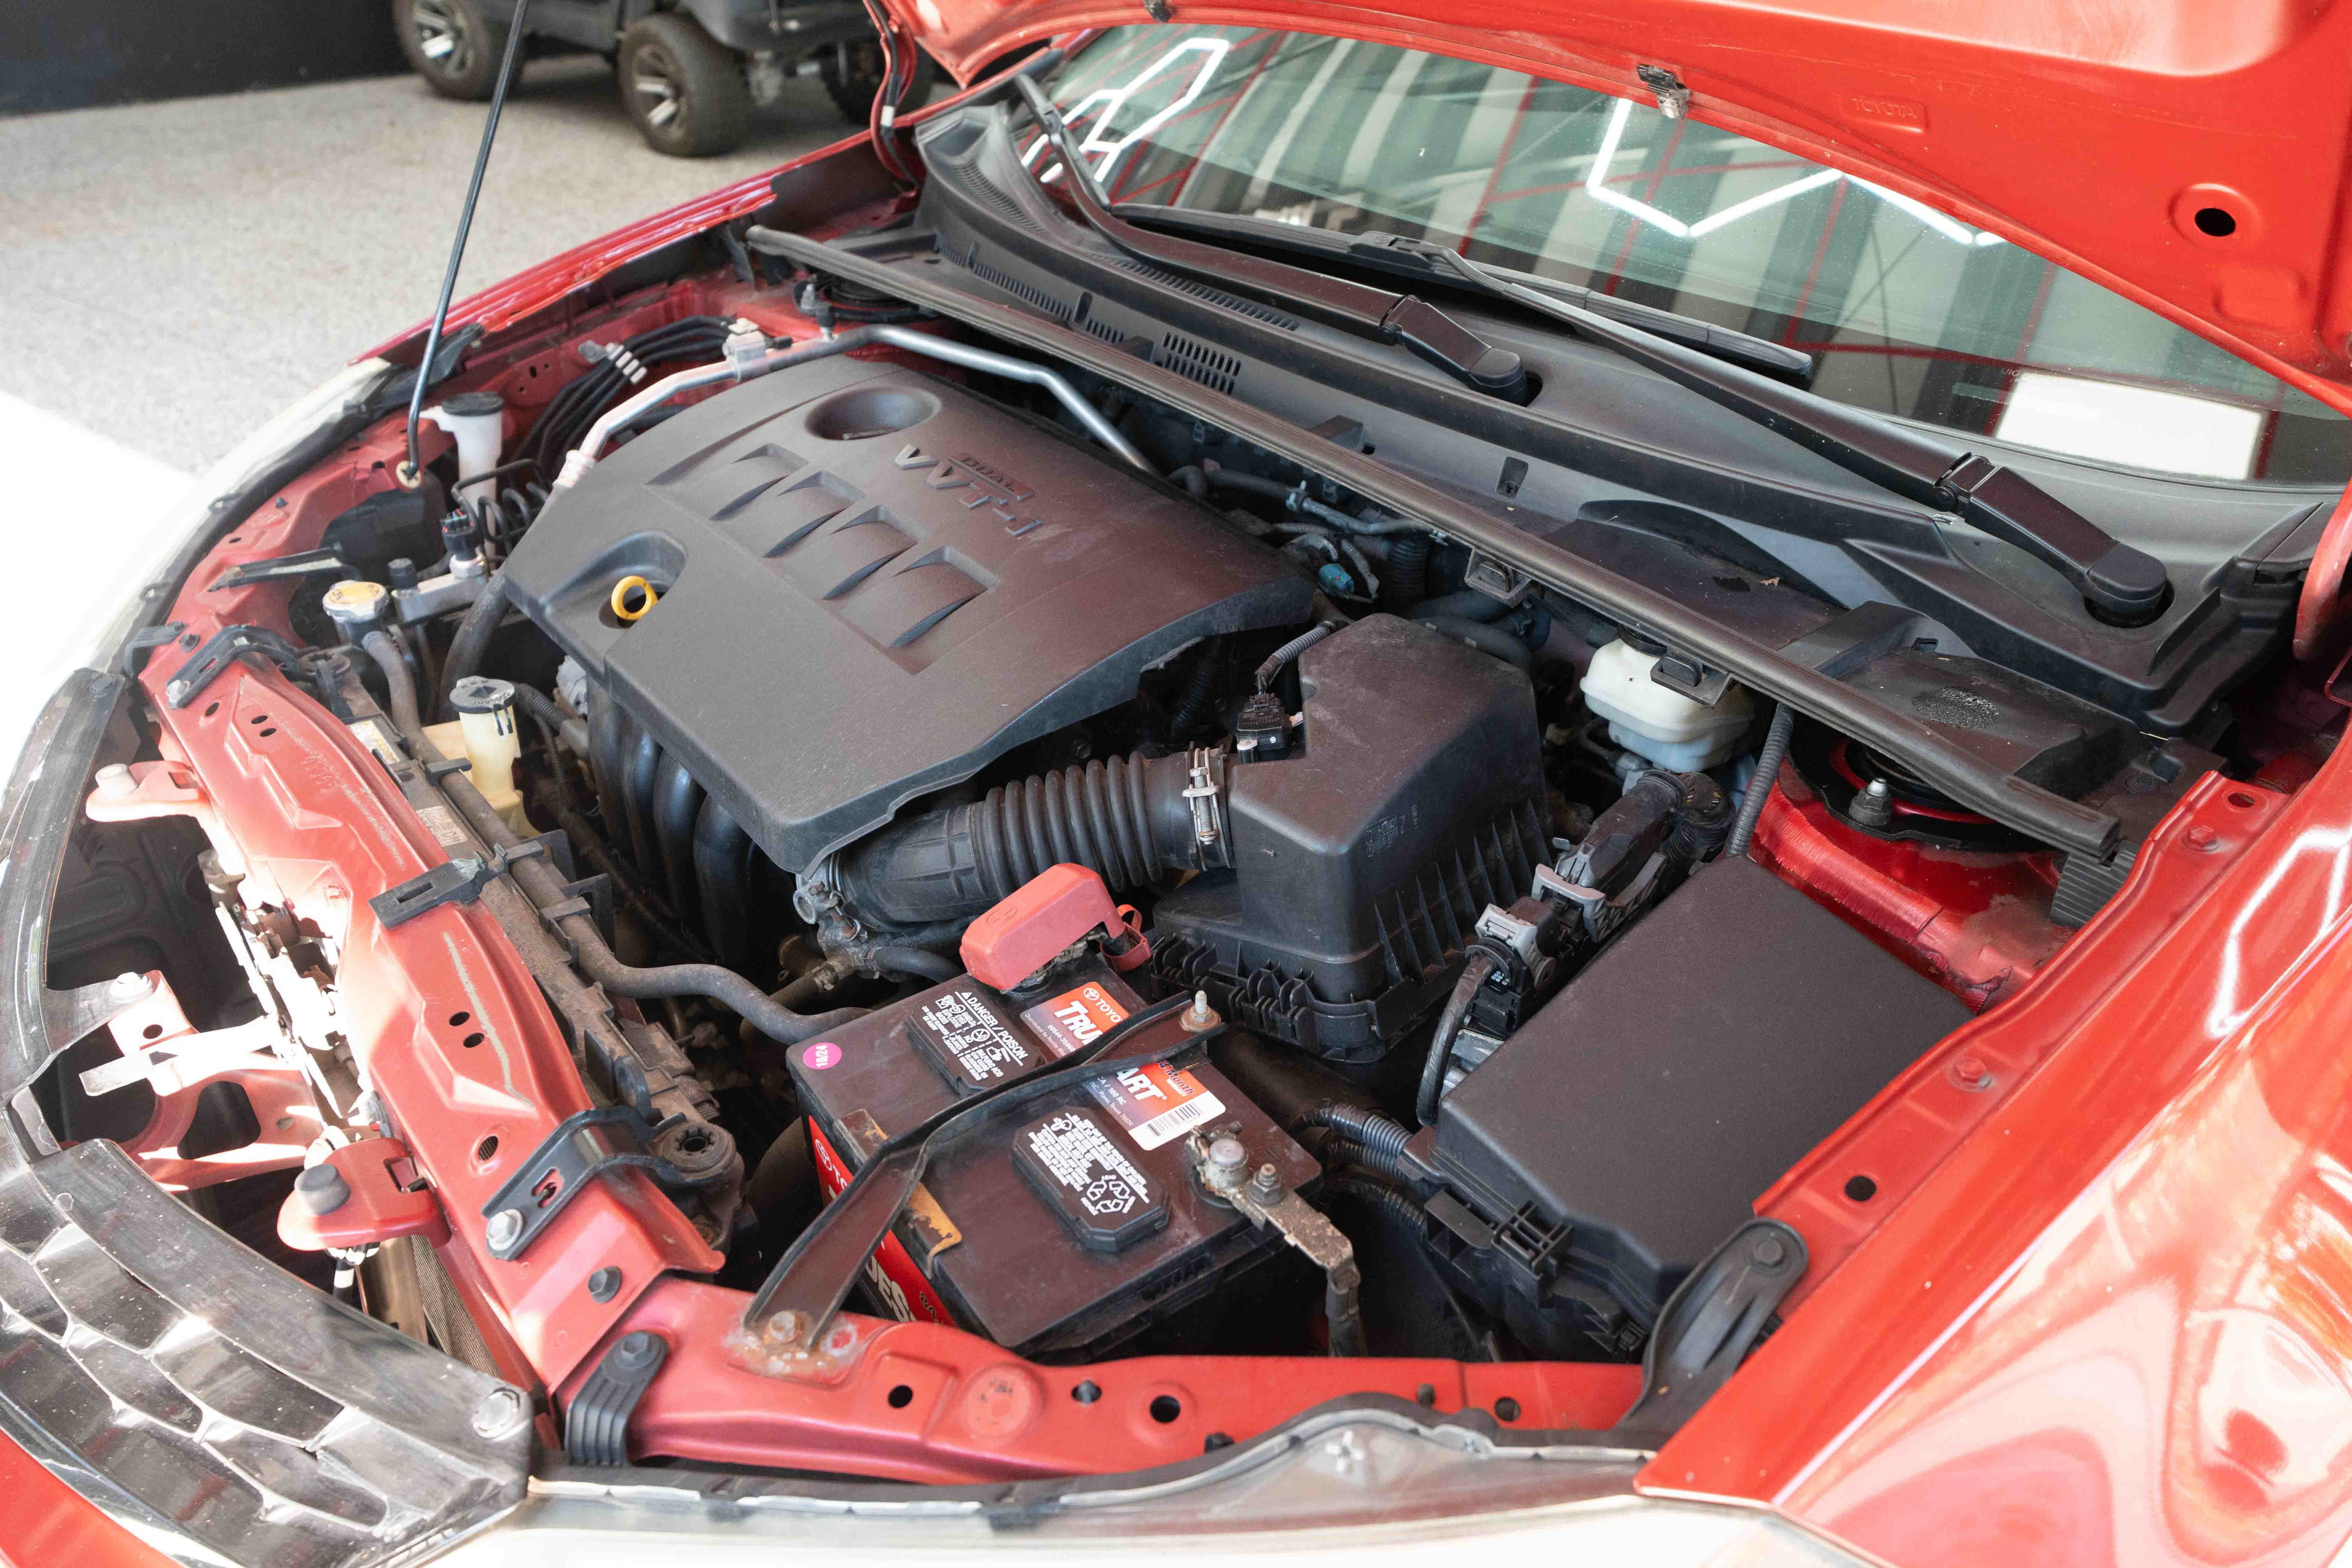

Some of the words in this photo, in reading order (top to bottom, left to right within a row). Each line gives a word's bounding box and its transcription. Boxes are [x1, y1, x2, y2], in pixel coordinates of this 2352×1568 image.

[1852, 97, 1918, 119] TOYOTA
[961, 457, 1016, 492] DUAL
[1096, 999, 1123, 1022] TOYO
[967, 997, 998, 1027] DANGER
[998, 1031, 1028, 1059] POISON
[1025, 1013, 1045, 1033] Distributed
[1047, 1036, 1059, 1049] Toyota
[816, 1045, 829, 1067] 10/24
[1156, 1061, 1194, 1094] 4-Month
[1108, 1087, 1119, 1097] 100
[1116, 1096, 1126, 1105] RC
